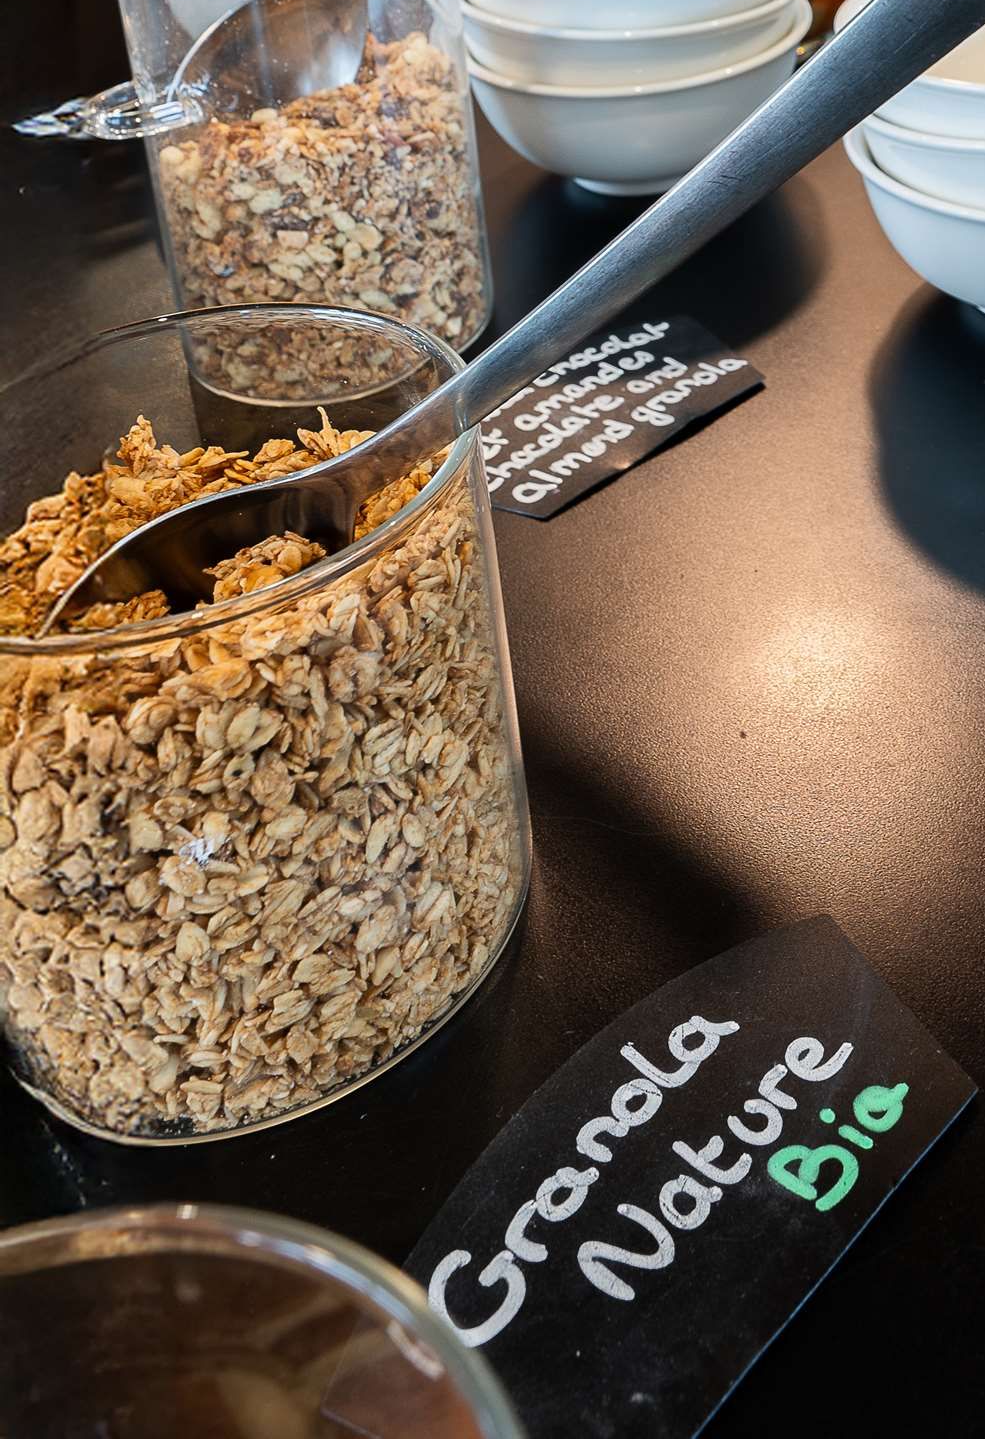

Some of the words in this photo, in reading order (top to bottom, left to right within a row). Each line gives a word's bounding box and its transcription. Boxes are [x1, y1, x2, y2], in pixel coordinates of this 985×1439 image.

[514, 350, 655, 431] amandes
[626, 356, 688, 394] and
[631, 358, 748, 427] granola
[427, 1015, 740, 1348] Granola
[577, 1036, 854, 1300] Nature
[766, 1082, 909, 1212] Bio
